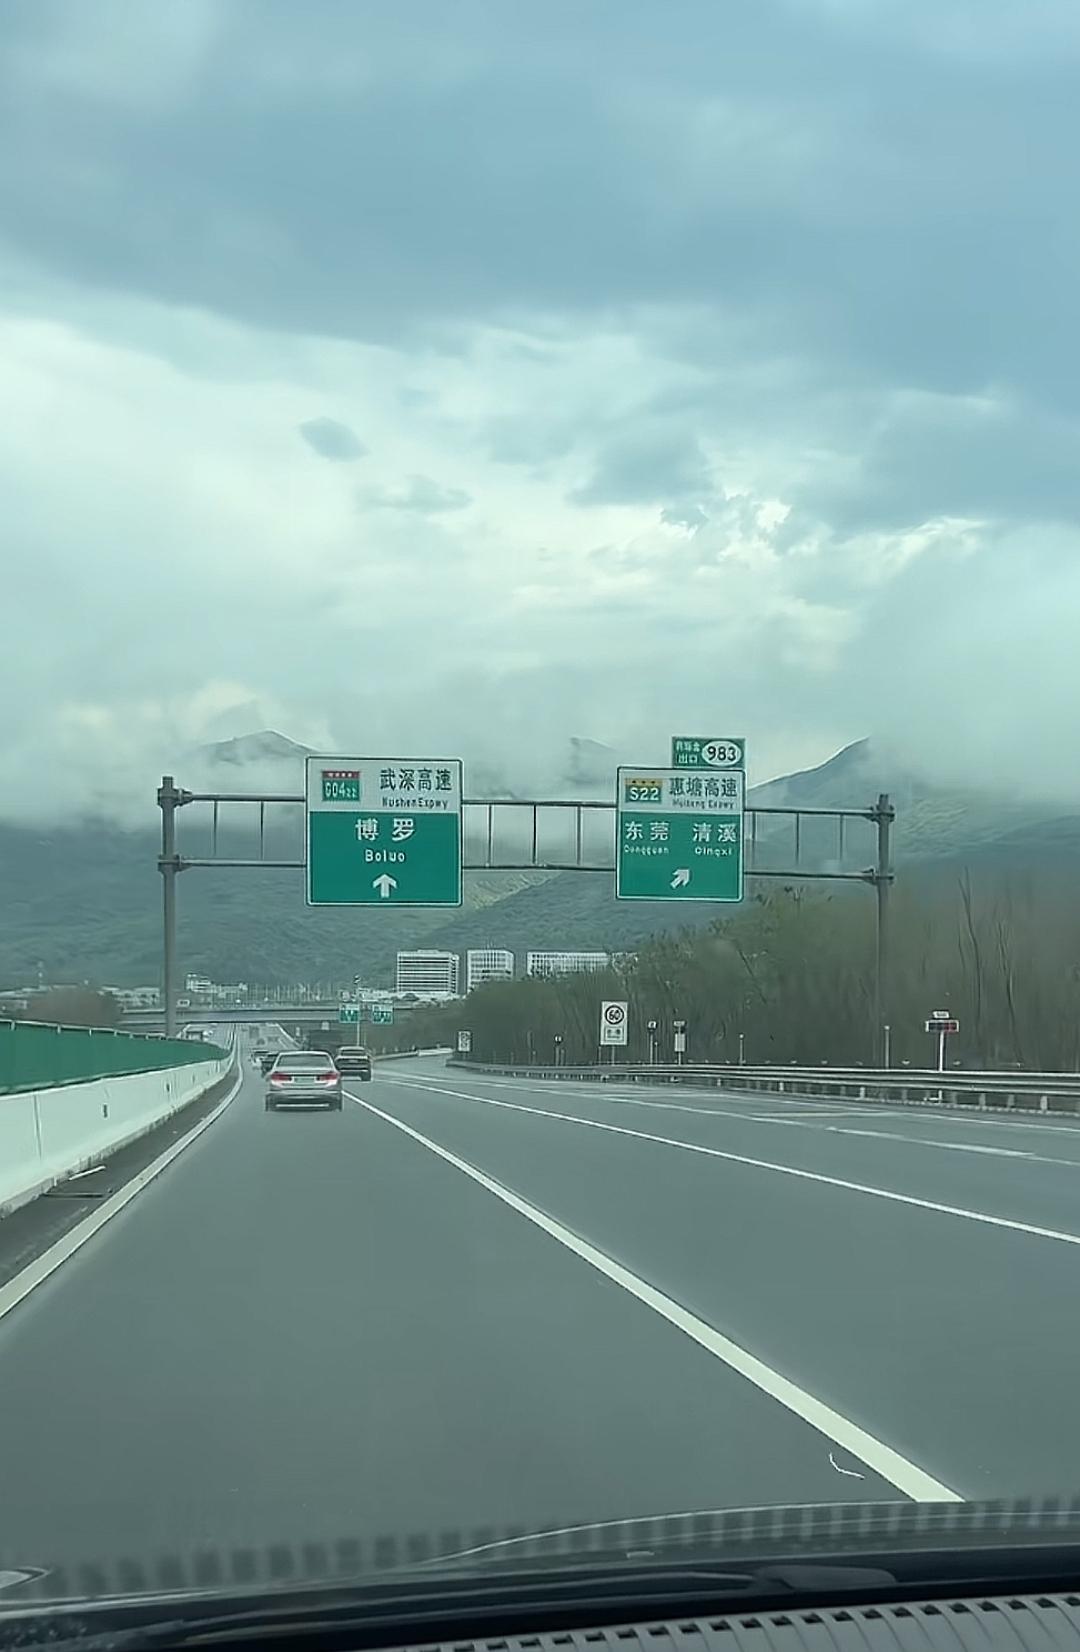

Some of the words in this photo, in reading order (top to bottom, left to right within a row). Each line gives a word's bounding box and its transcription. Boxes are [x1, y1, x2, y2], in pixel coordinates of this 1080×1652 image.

[707, 746, 736, 761] 983
[380, 768, 452, 791] 武深高速
[669, 778, 737, 797] 惠塘高速
[630, 787, 659, 801] S22
[355, 818, 415, 842] 博罗
[625, 821, 670, 841] 东莞
[693, 822, 737, 842] 清溪
[365, 850, 405, 862] Boluo
[609, 1009, 621, 1021] 60
